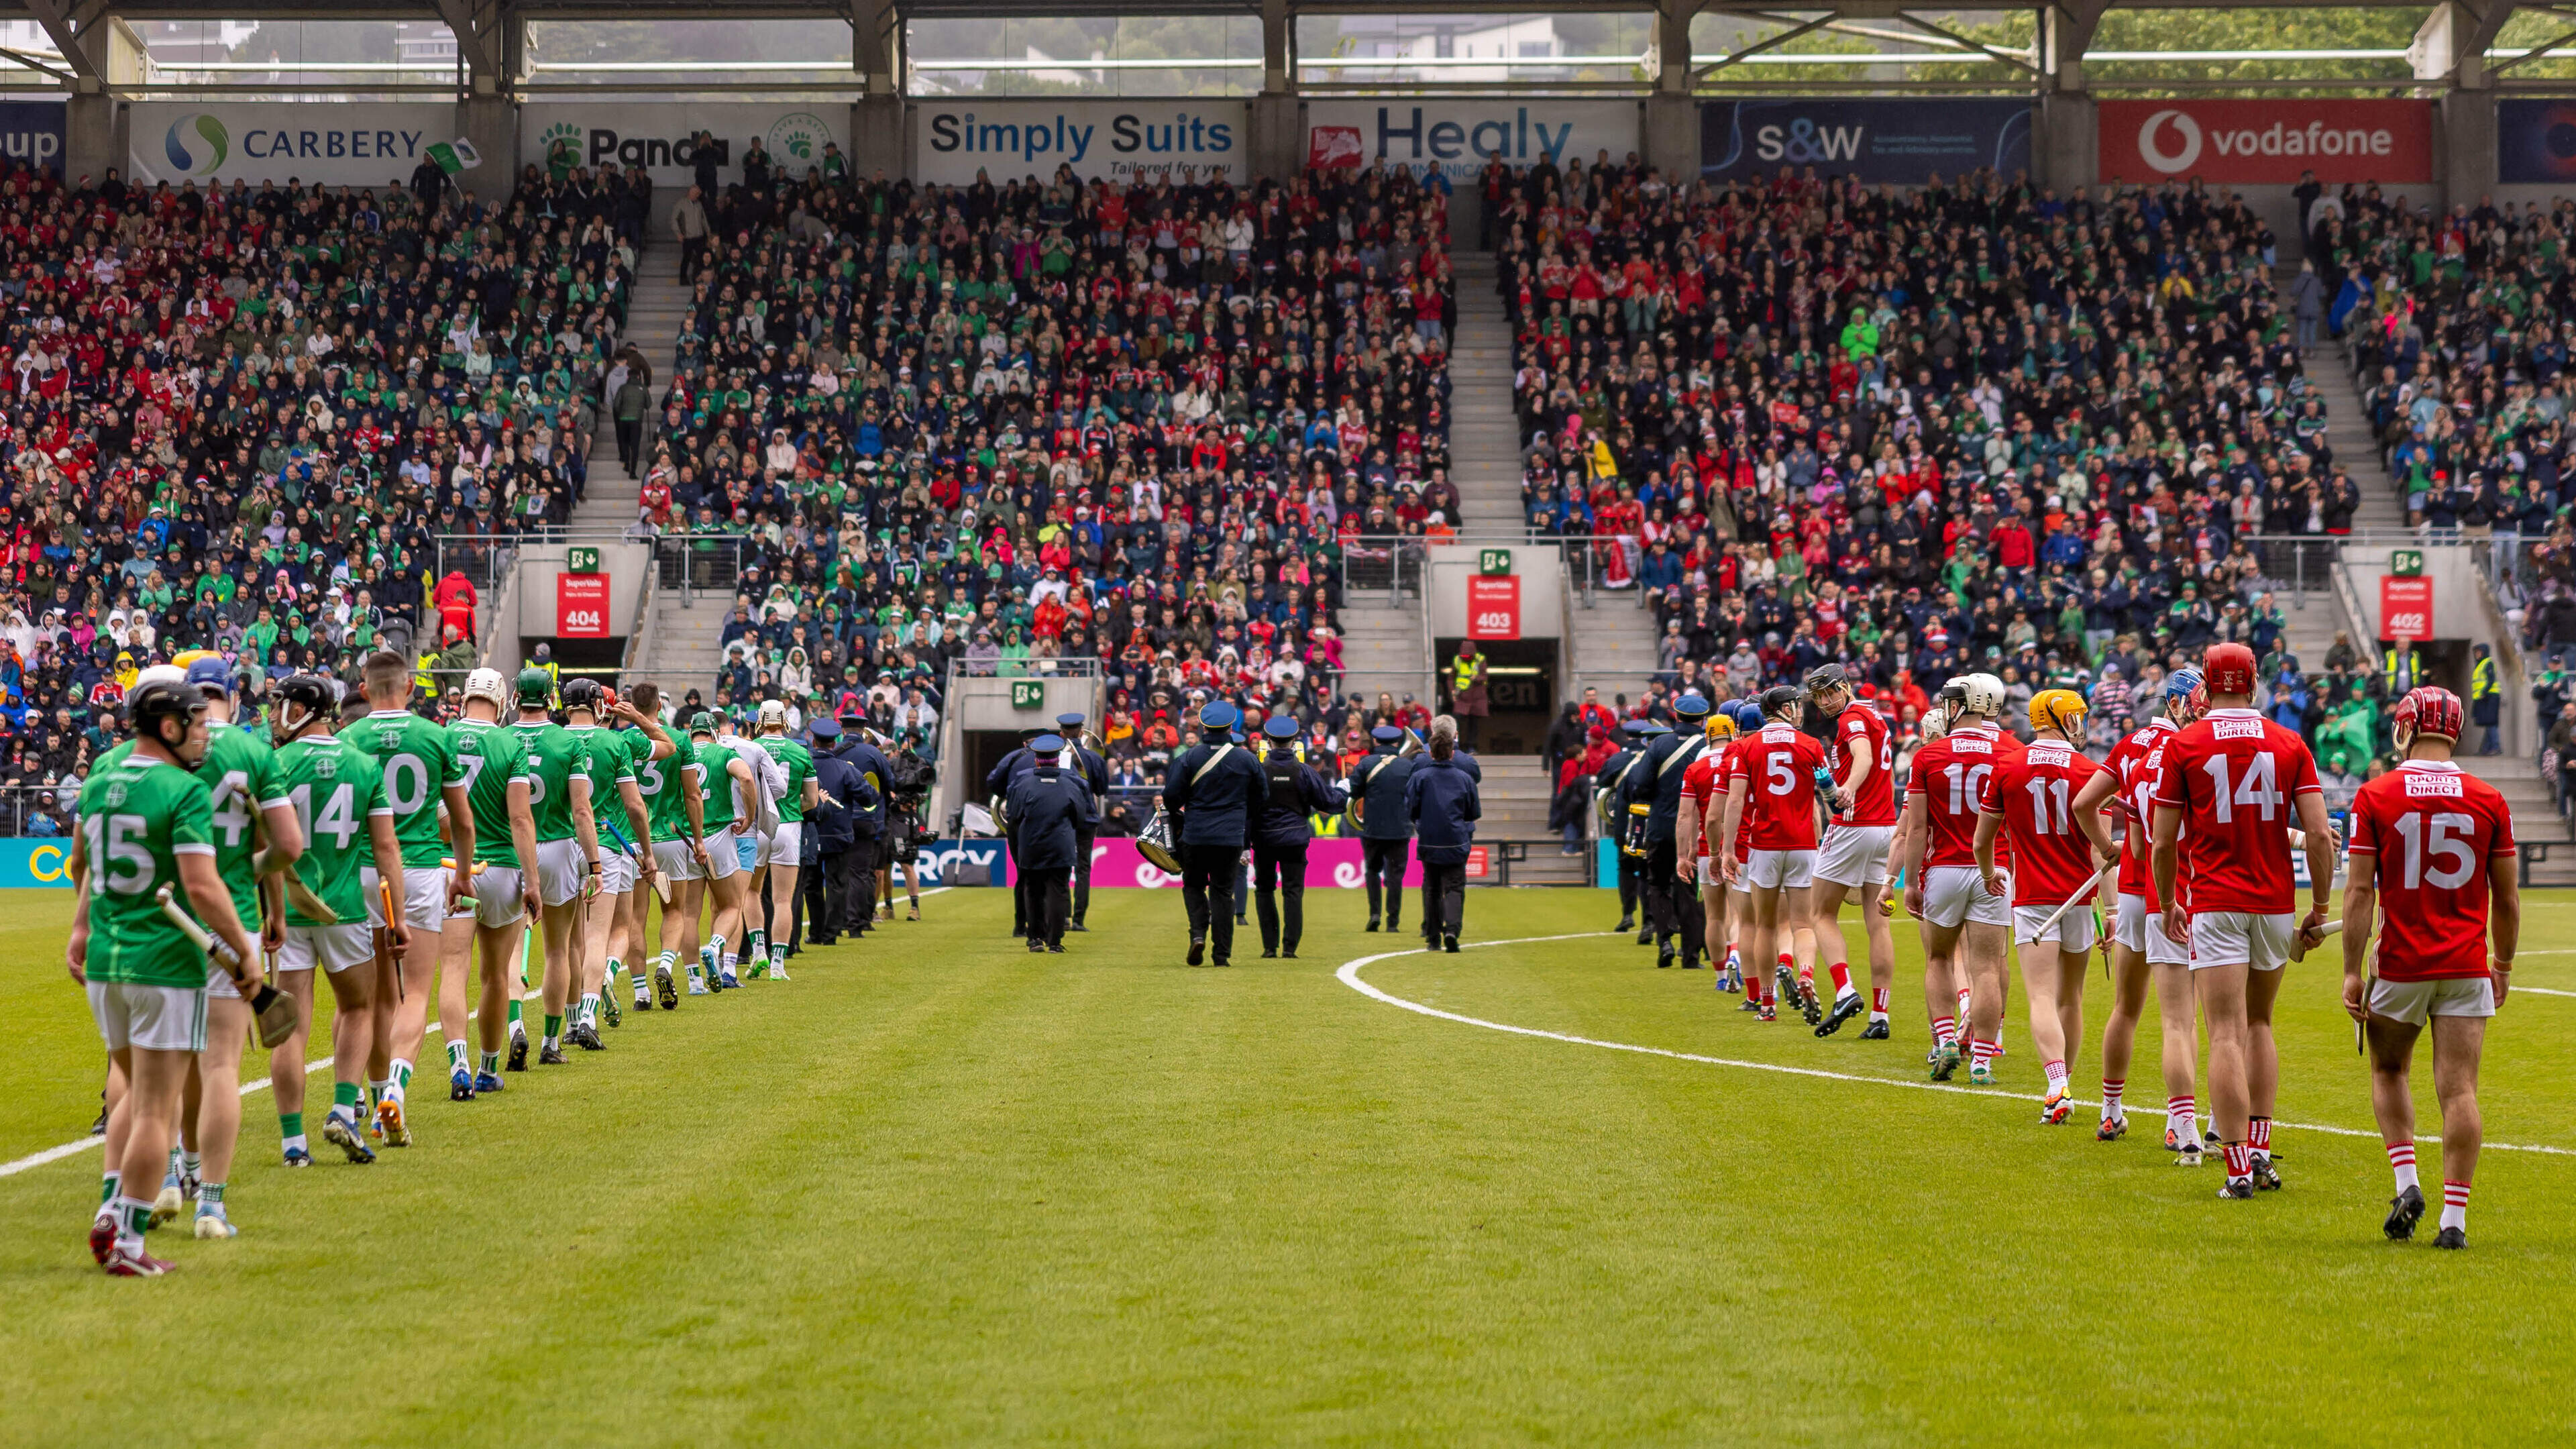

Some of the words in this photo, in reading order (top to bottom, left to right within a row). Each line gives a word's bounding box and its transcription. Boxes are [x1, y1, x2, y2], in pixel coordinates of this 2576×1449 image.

[0, 133, 58, 168] up
[244, 130, 422, 158] CARBERY
[930, 113, 1093, 162] Simply
[1112, 113, 1232, 152] Suits
[1377, 107, 1572, 165] Healy
[1757, 118, 1862, 162] S&W
[2211, 121, 2392, 156] vodafone
[1111, 162, 1172, 174] Tailored
[1176, 162, 1198, 174] for
[566, 610, 600, 626] 404
[1477, 612, 1511, 627] 403
[2390, 613, 2425, 629] 402
[2217, 720, 2259, 729] SPORTS
[2218, 729, 2260, 737] DIRECT
[1880, 729, 1892, 771] 6
[2031, 757, 2067, 765] DIRECT
[369, 753, 428, 815] 0
[457, 754, 484, 796] 7
[634, 760, 663, 795] 3
[1767, 751, 1796, 796] 5
[1943, 763, 1994, 815] 10
[2203, 751, 2284, 824] 14
[2409, 775, 2457, 784] SPORTS
[2410, 786, 2458, 795] DIRECT
[288, 783, 360, 849] 14
[2025, 776, 2069, 835] 11
[83, 813, 156, 895] 15
[2394, 812, 2476, 890] 15
